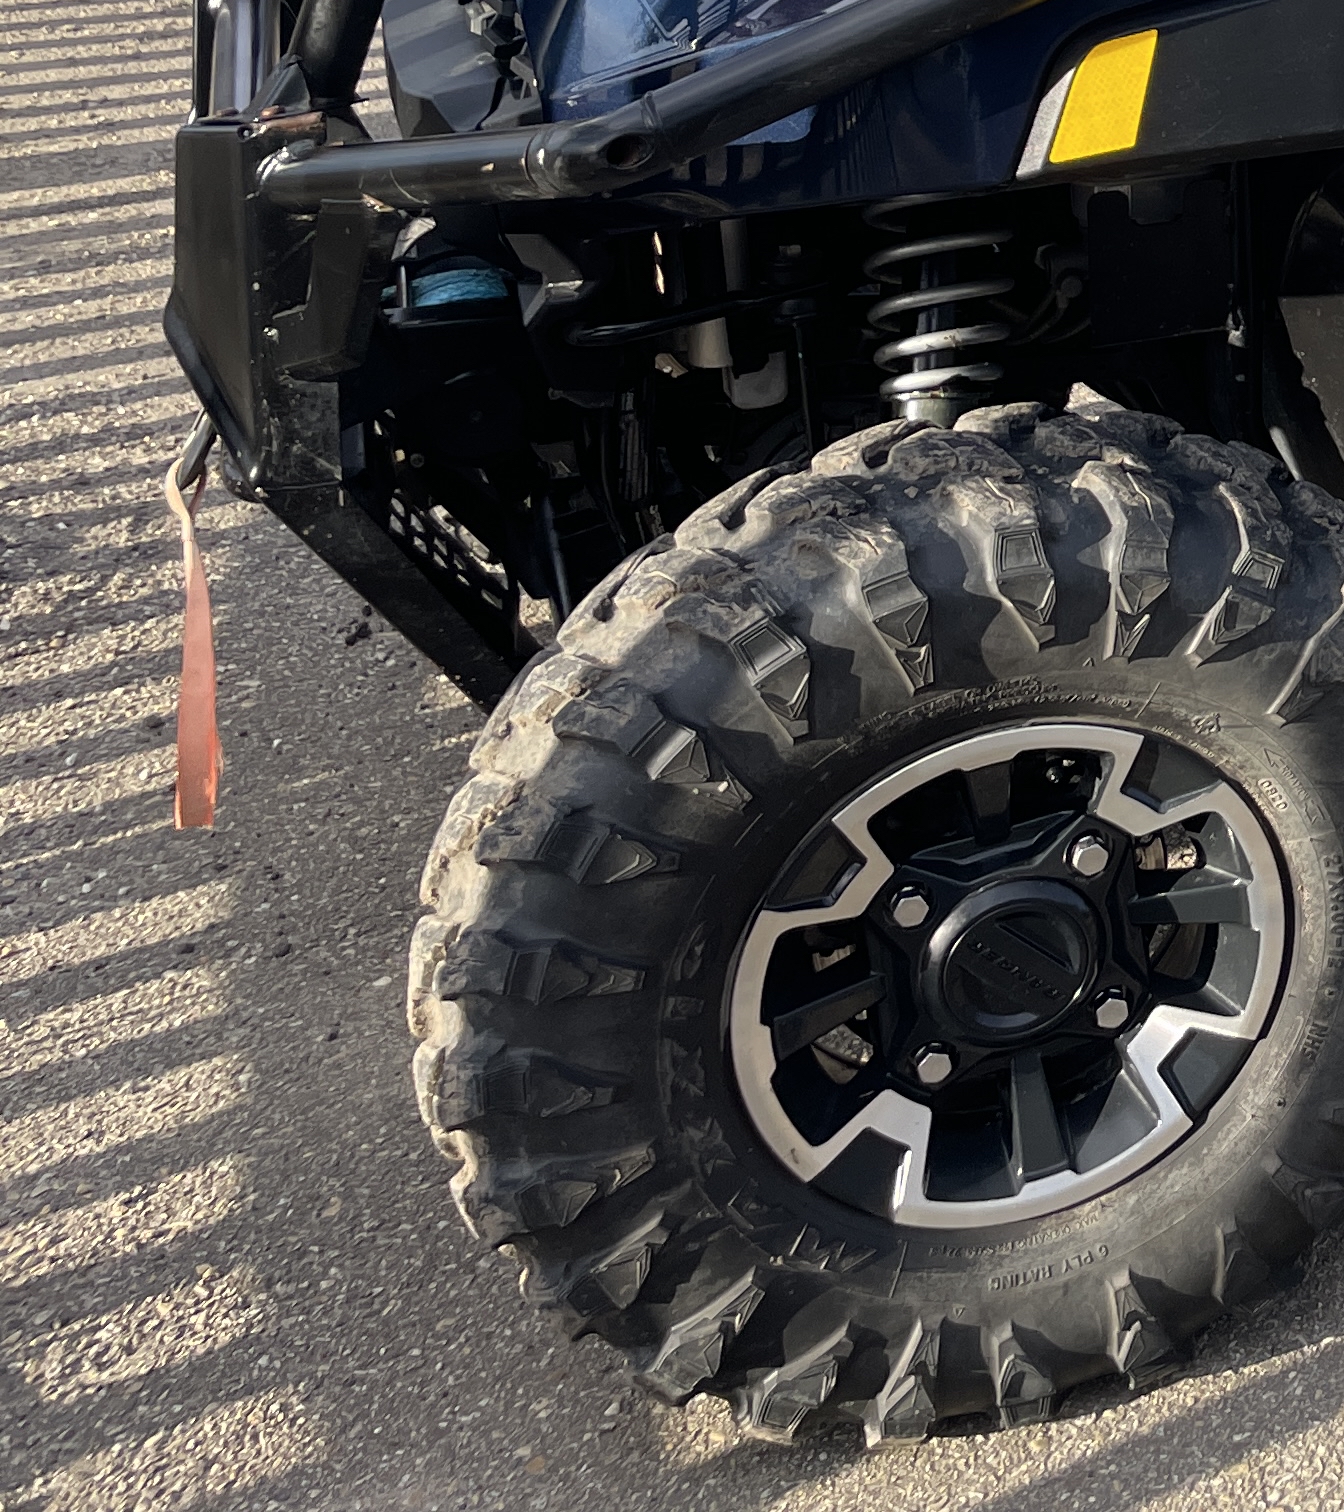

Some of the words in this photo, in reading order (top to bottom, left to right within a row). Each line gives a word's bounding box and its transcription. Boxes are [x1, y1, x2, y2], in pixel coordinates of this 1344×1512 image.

[1301, 1023, 1329, 1061] NHS
[1061, 1250, 1095, 1274] PLY
[1098, 1243, 1109, 1258] 6
[987, 1263, 1054, 1292] RATING
